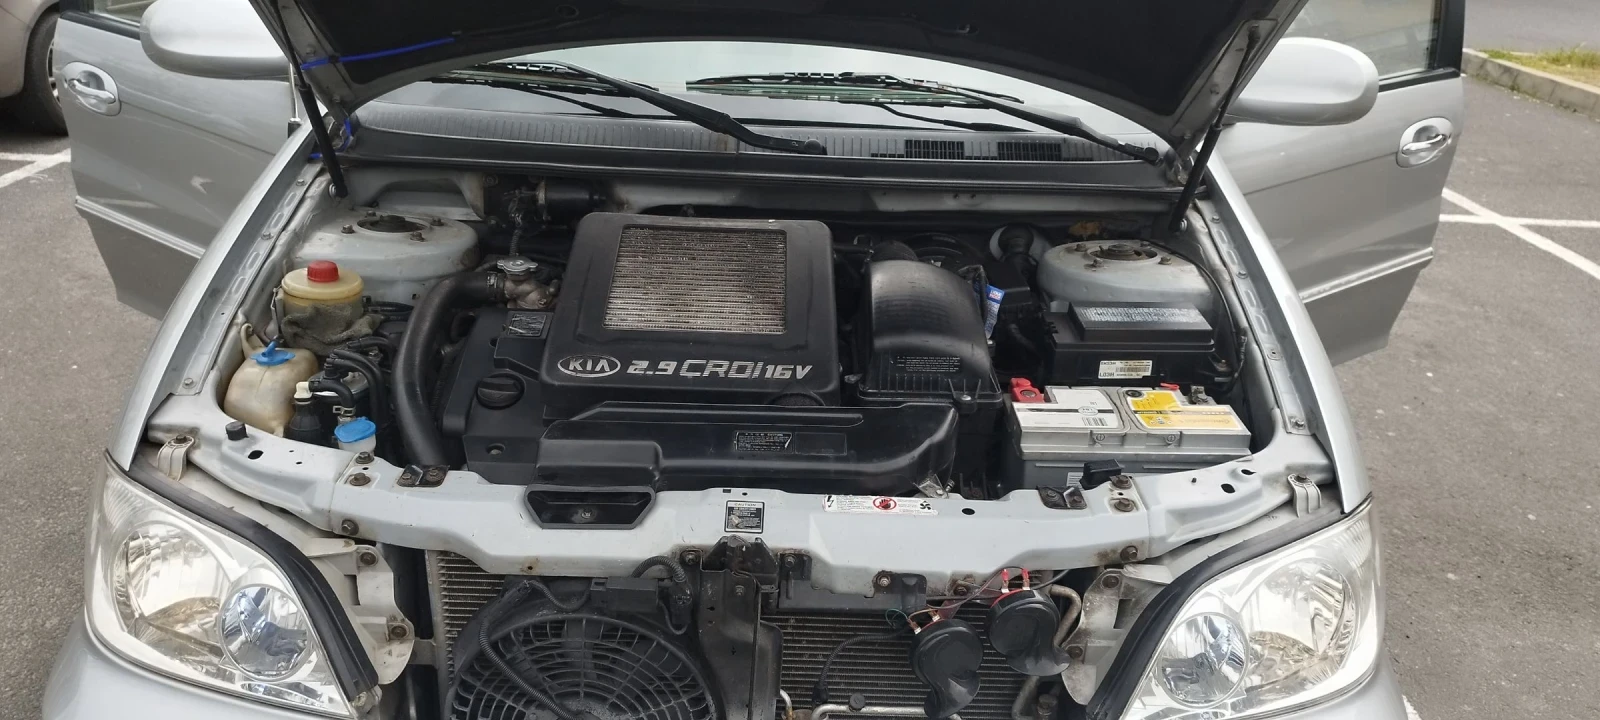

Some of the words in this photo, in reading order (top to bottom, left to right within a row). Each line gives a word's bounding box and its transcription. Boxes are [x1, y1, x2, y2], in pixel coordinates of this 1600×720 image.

[568, 359, 611, 372] KIA
[626, 359, 678, 375] 2.9
[764, 364, 813, 380] 16V
